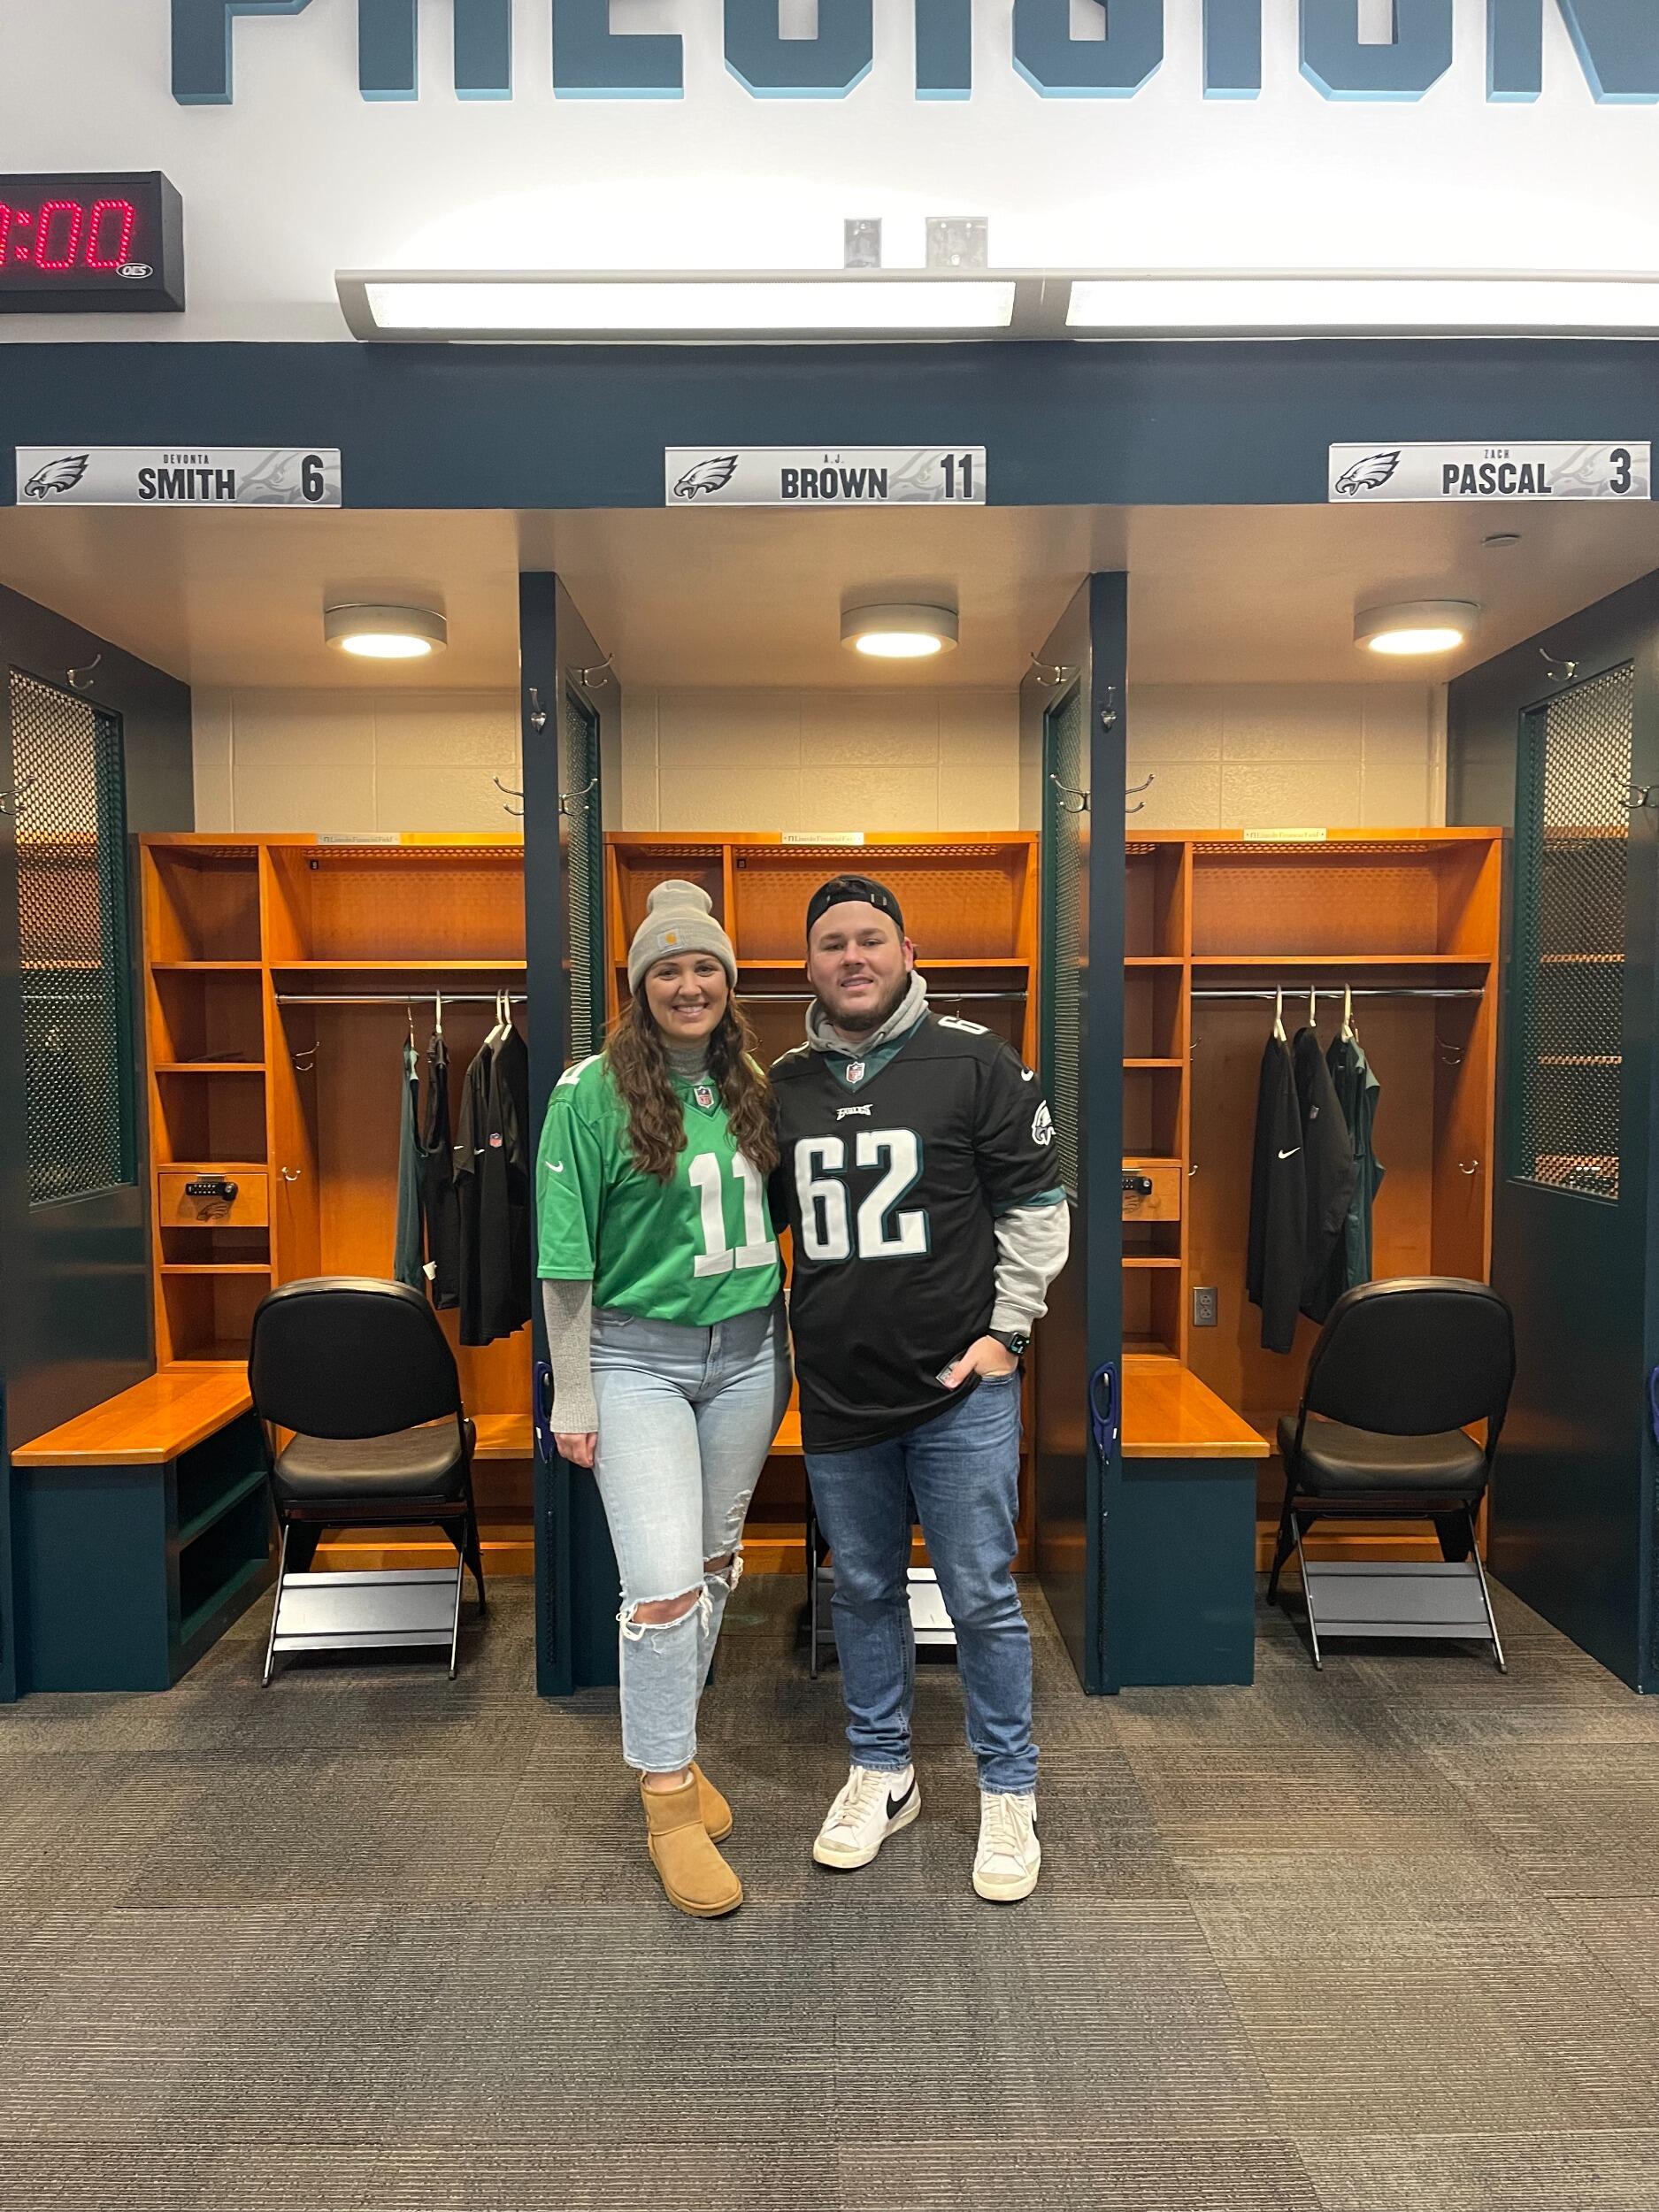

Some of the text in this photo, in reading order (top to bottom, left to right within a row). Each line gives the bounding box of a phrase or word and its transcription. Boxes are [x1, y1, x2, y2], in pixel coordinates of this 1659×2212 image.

[163, 454, 210, 465] DEVONTA
[781, 453, 973, 499] BROWN 11
[824, 454, 844, 464] A.J.
[1442, 448, 1632, 495] PASCAL 3
[1485, 449, 1510, 459] ZACH
[138, 454, 325, 502] SMITH 6
[688, 1152, 779, 1279] 11
[795, 1128, 930, 1261] 62
